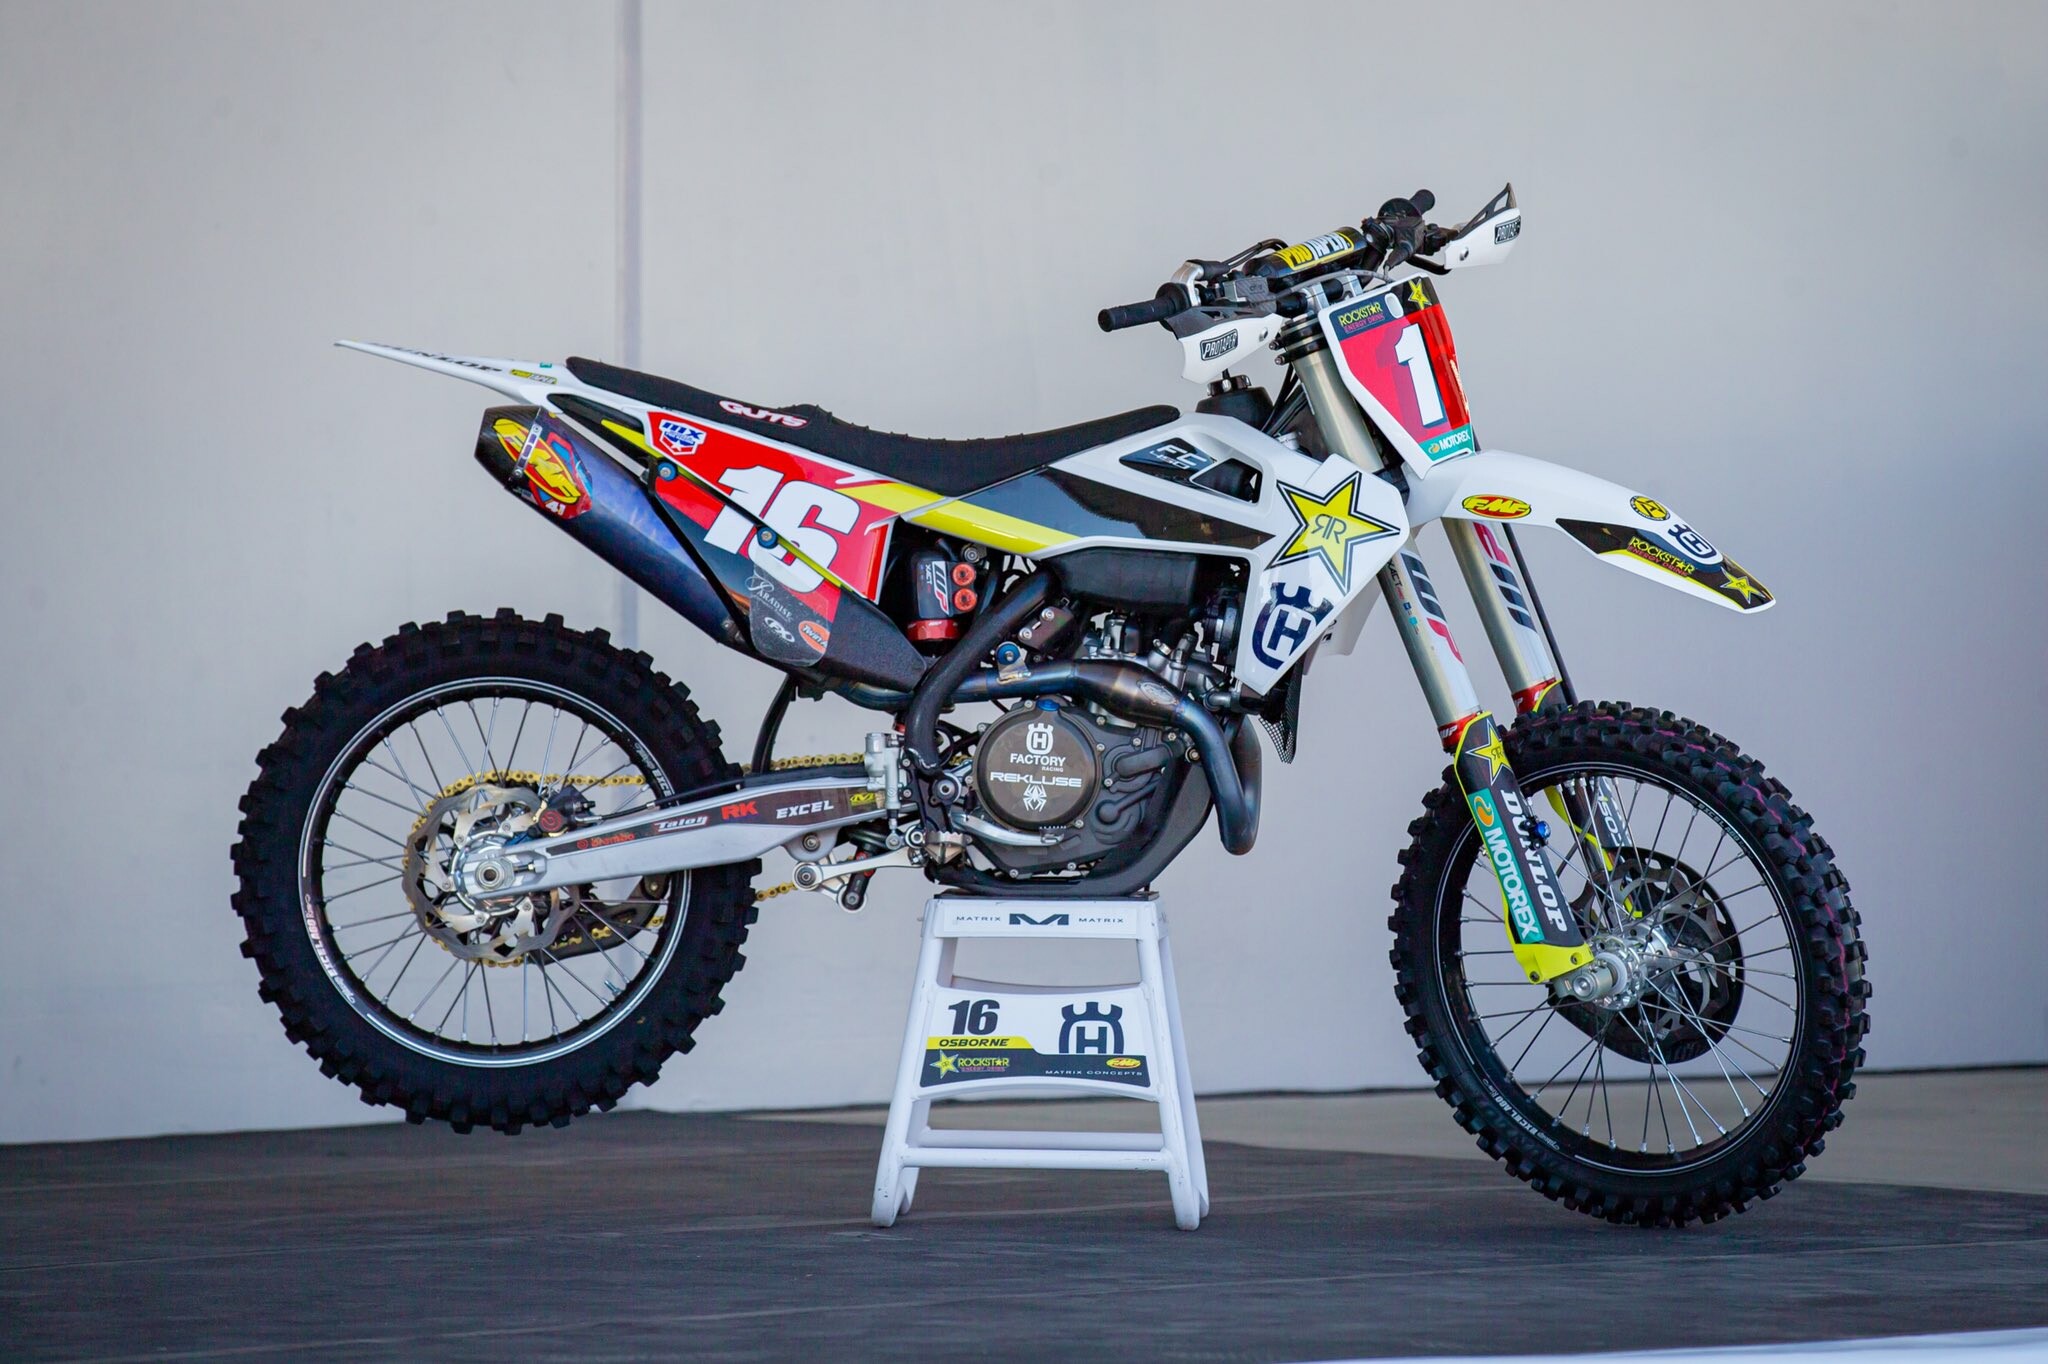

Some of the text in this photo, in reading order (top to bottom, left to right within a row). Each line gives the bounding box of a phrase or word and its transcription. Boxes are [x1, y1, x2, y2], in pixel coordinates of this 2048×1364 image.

[1395, 323, 1444, 426] 1
[719, 400, 808, 428] GUTS
[1438, 429, 1471, 450] MOTOREX
[1463, 497, 1531, 515] FMF
[703, 465, 861, 593] 16
[1010, 753, 1066, 767] FACTORY
[652, 769, 673, 797] EXCE
[990, 772, 1082, 787] REKLUSE
[720, 801, 759, 820] RK
[776, 800, 834, 819] EXCEL
[1697, 803, 1726, 827] EXCEL
[1501, 788, 1567, 932] DUNLOP
[1485, 827, 1540, 939] MOTOREX
[947, 999, 1000, 1036] 16
[939, 1038, 1010, 1047] OSBORNE
[1510, 1110, 1538, 1136] EXCEL
